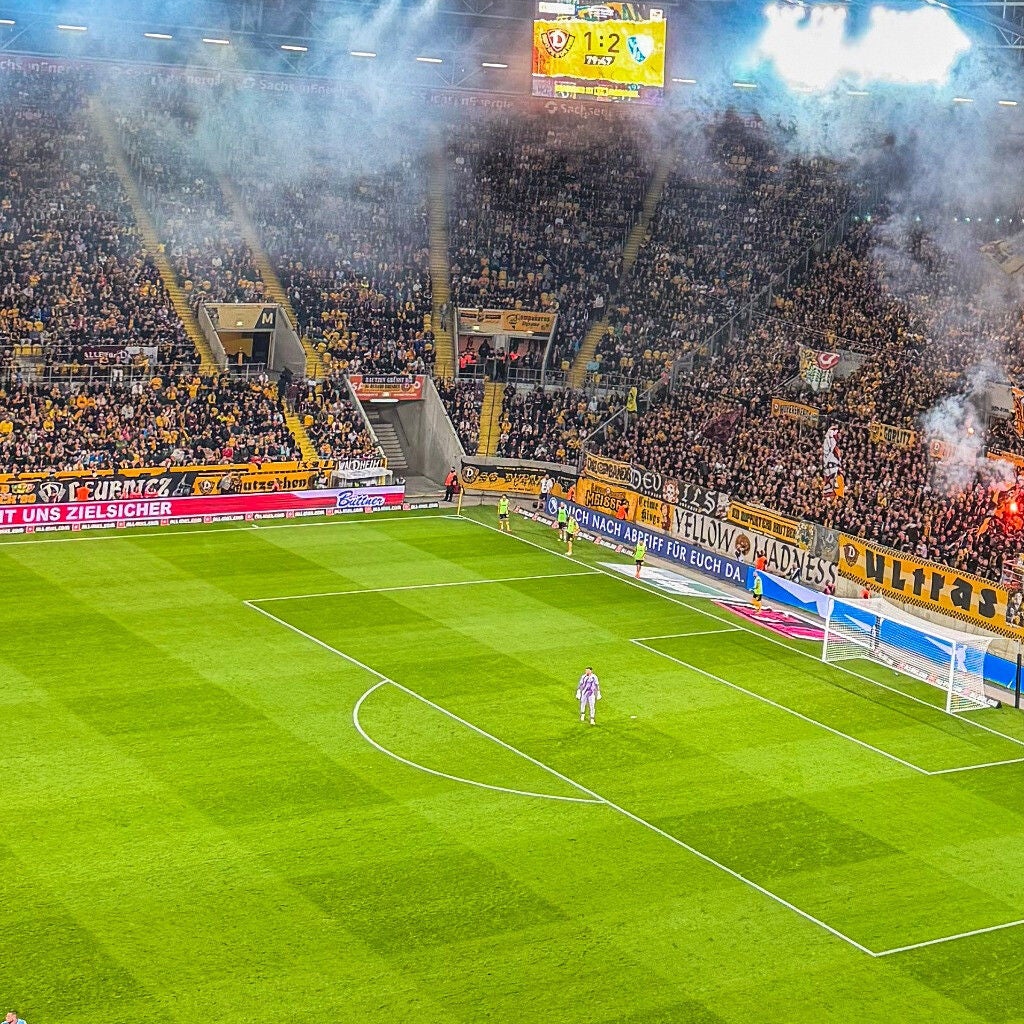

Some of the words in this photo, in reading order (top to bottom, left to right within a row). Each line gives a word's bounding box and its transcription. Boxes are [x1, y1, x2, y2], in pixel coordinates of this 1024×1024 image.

[261, 312, 274, 325] M
[22, 507, 61, 523] UNS
[65, 501, 173, 520] ZIELSICHER
[592, 515, 622, 537] NACH
[666, 540, 687, 561] FÜR
[690, 550, 721, 575] EUCH
[674, 508, 736, 553] YELLOW
